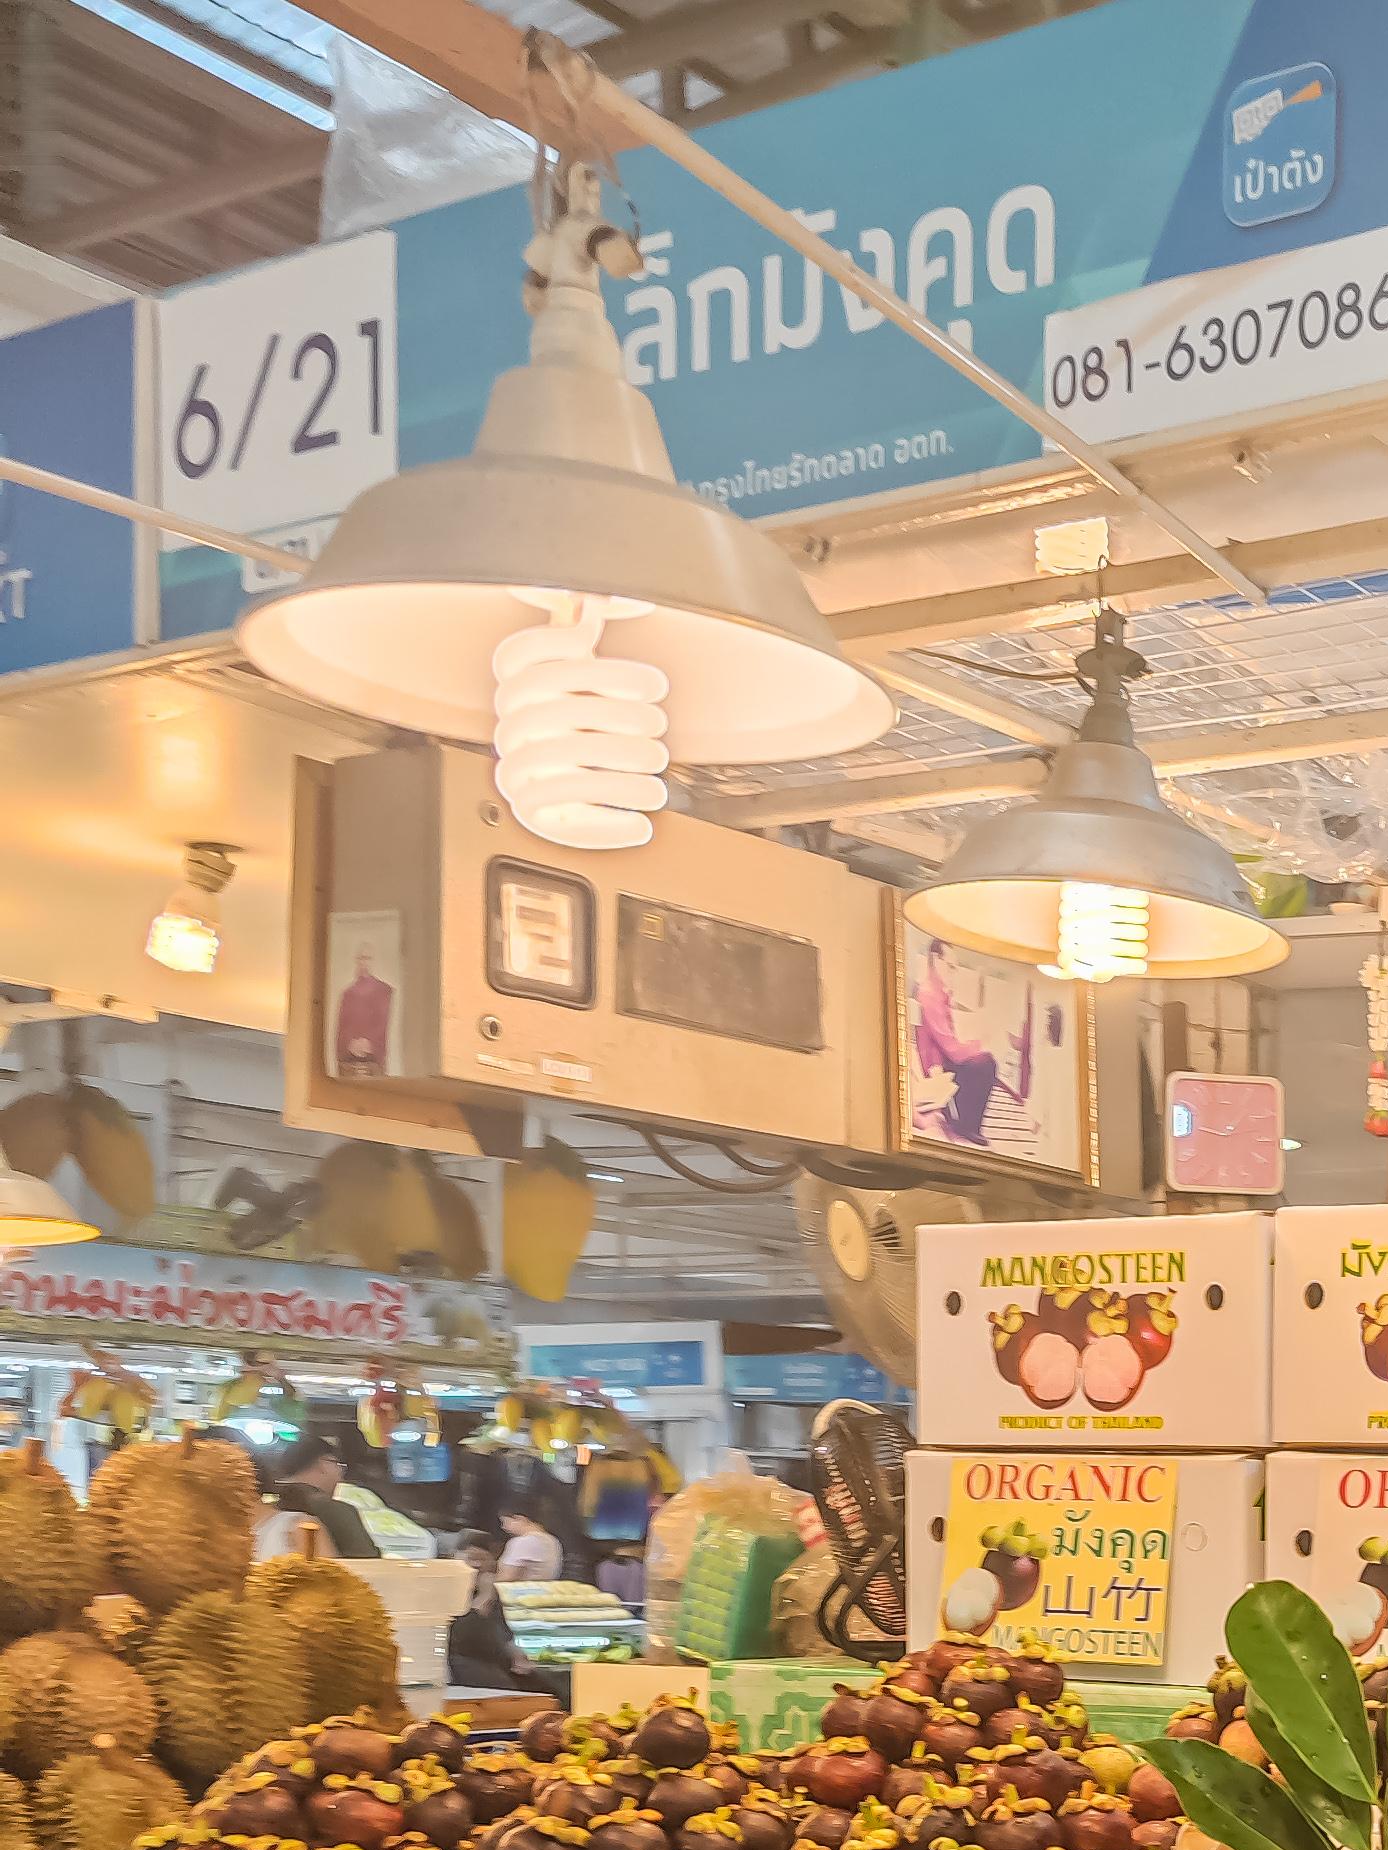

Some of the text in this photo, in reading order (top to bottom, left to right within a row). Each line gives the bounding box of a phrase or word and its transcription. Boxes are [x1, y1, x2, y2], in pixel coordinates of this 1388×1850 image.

[174, 318, 386, 481] 6/21
[980, 1251, 1187, 1287] MANGOSTEEN
[999, 1416, 1164, 1430] PRODUCT OF THAILAND
[965, 1463, 1167, 1503] ORGANIC
[1053, 1509, 1169, 1574] มังคุด
[1042, 1575, 1164, 1622] 山竹
